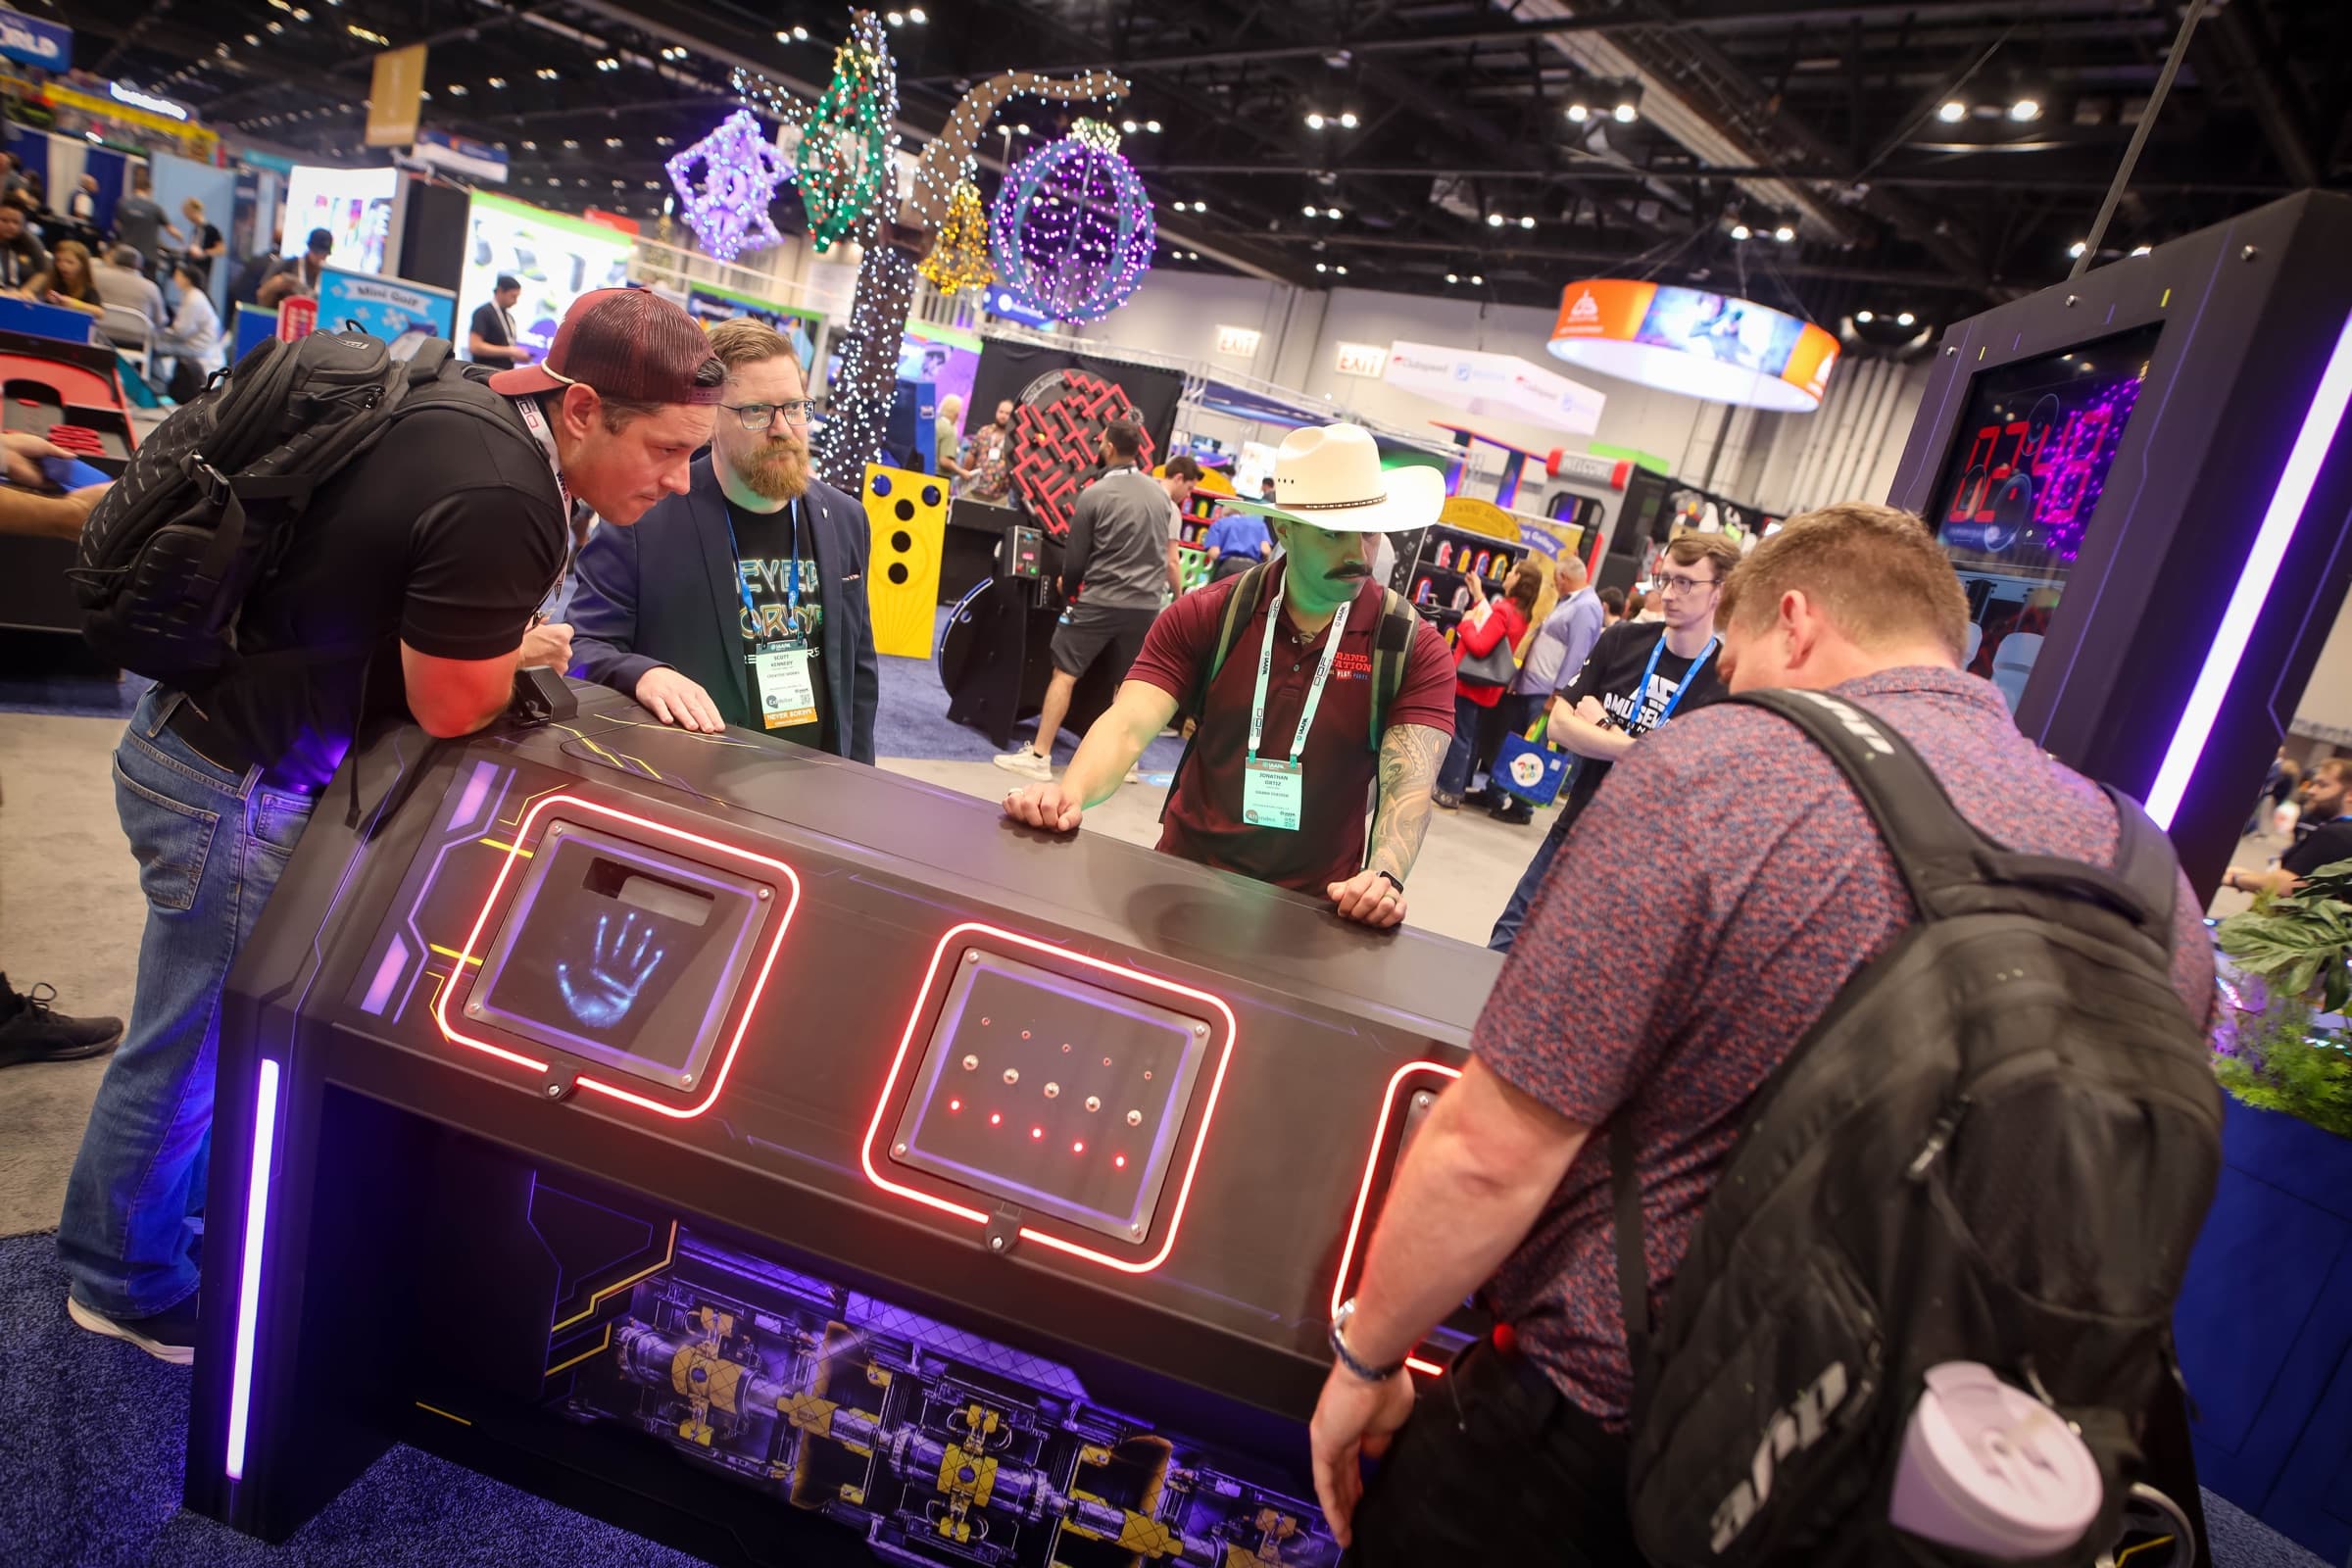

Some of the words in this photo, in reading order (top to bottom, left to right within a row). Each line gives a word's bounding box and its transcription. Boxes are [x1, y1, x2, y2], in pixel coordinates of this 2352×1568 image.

[357, 285, 386, 300] Mini
[391, 292, 421, 308] Golf
[1220, 335, 1254, 356] EXIT
[1339, 355, 1380, 373] EXIT
[1335, 652, 1368, 662] RAND
[1334, 661, 1372, 673] ATION
